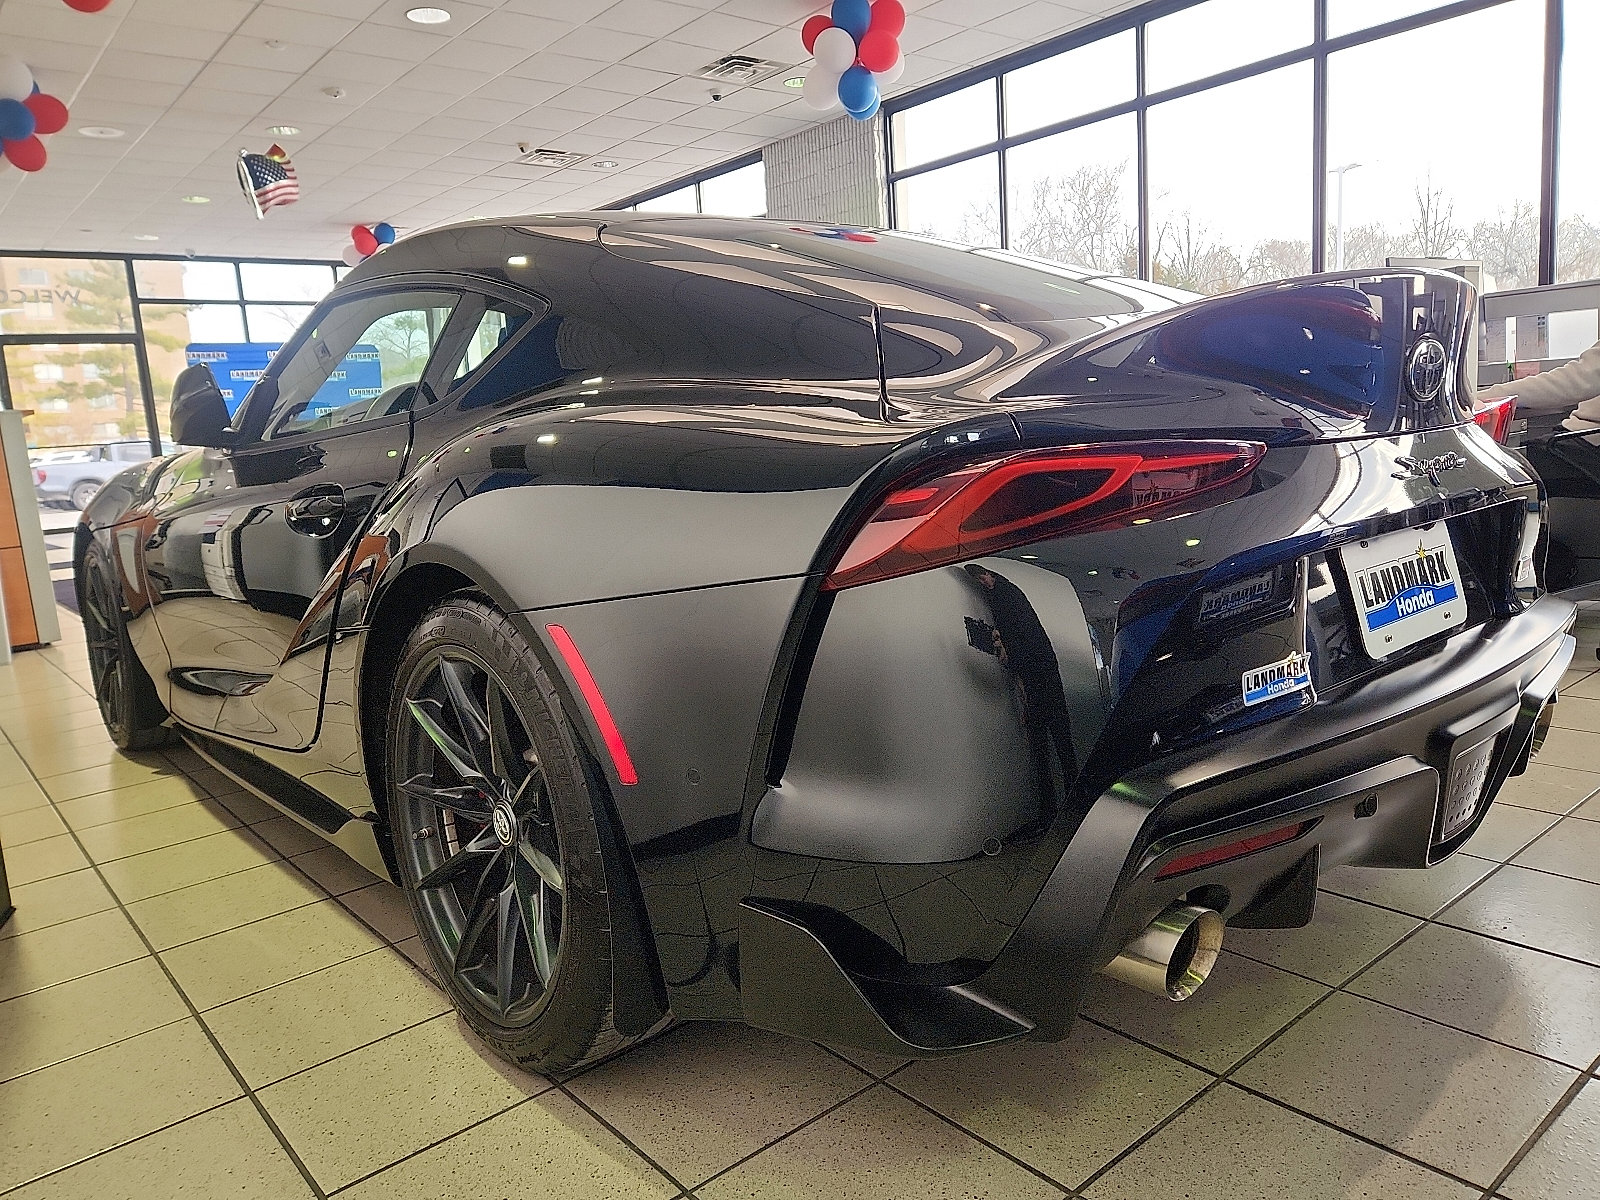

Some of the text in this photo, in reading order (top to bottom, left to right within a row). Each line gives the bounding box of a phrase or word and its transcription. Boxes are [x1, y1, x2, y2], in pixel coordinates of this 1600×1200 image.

[1358, 550, 1451, 608] LANDMARK
[1395, 588, 1435, 617] Honda
[1246, 658, 1306, 692] LANDMARK
[1267, 679, 1295, 694] Honda
